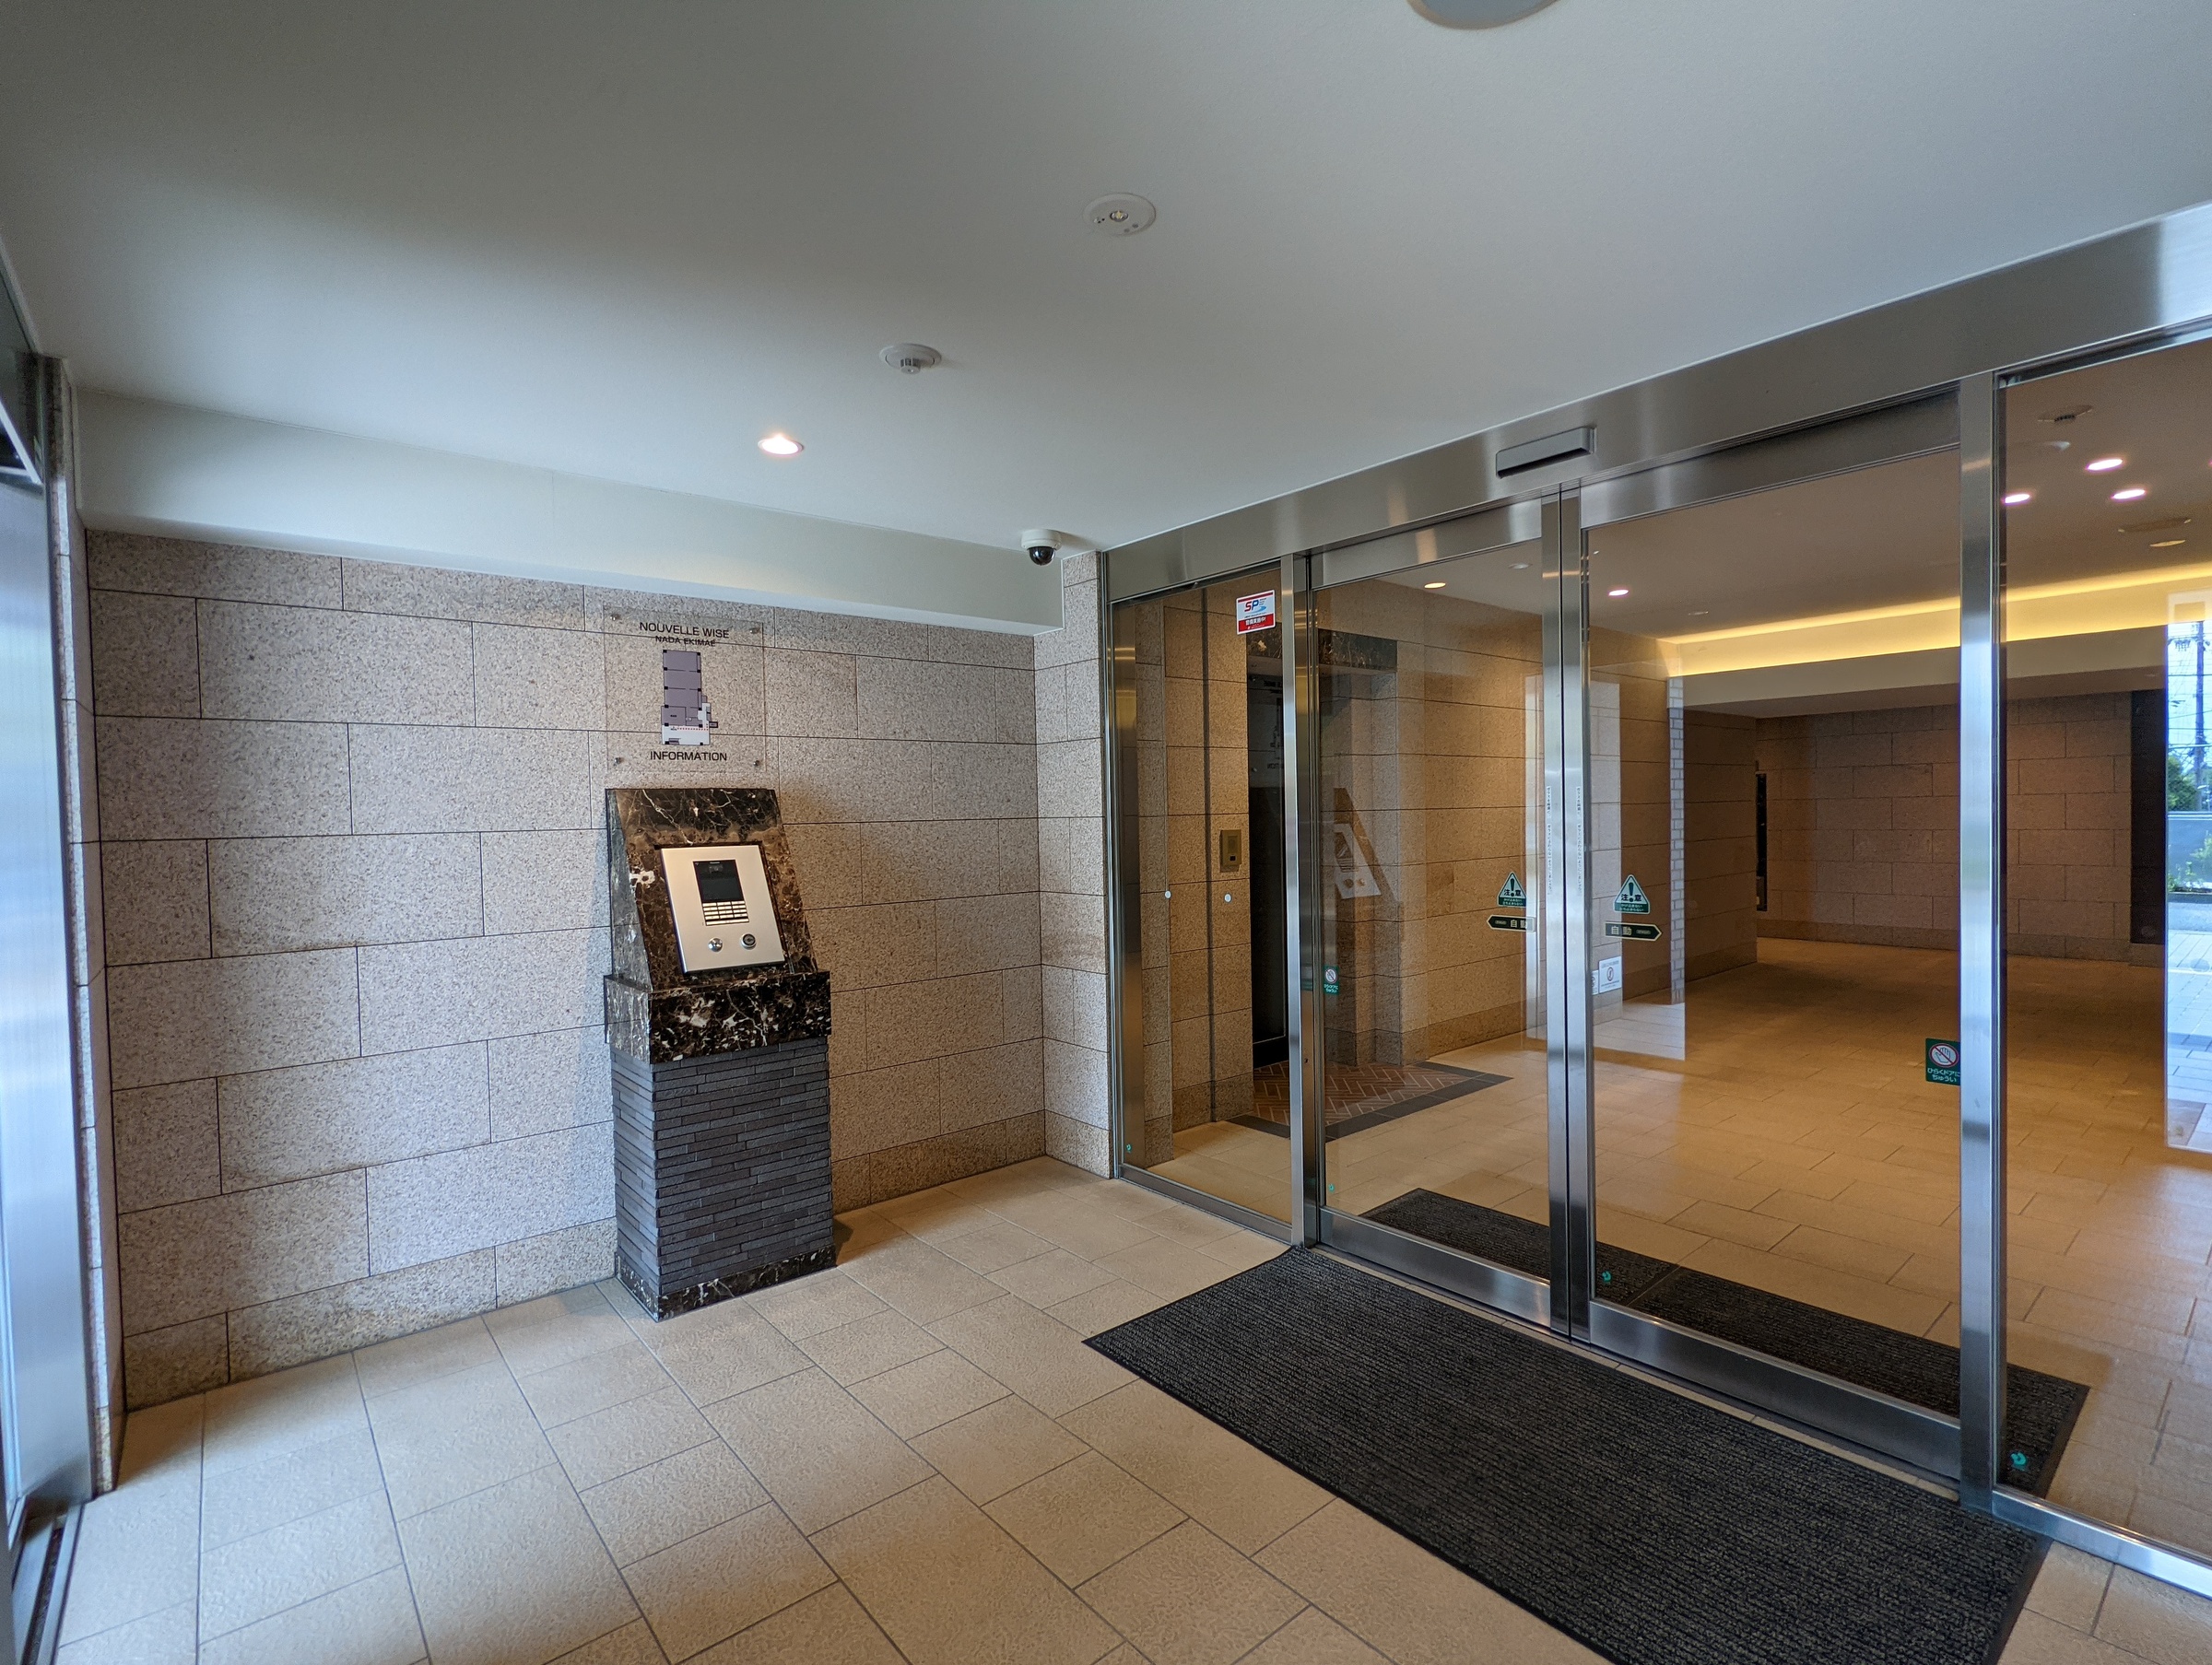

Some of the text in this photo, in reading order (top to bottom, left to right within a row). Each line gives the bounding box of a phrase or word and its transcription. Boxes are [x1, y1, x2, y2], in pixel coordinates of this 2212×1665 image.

[1244, 599, 1259, 612] SP
[640, 622, 730, 639] NOUVELLE WISE
[655, 636, 715, 647] NADA EKIMAE
[650, 751, 727, 761] INFORMATION
[1611, 926, 1632, 935] 自動
[1927, 1068, 1960, 1077] ひらくドアに
[1932, 1074, 1957, 1083] ちゅうい
